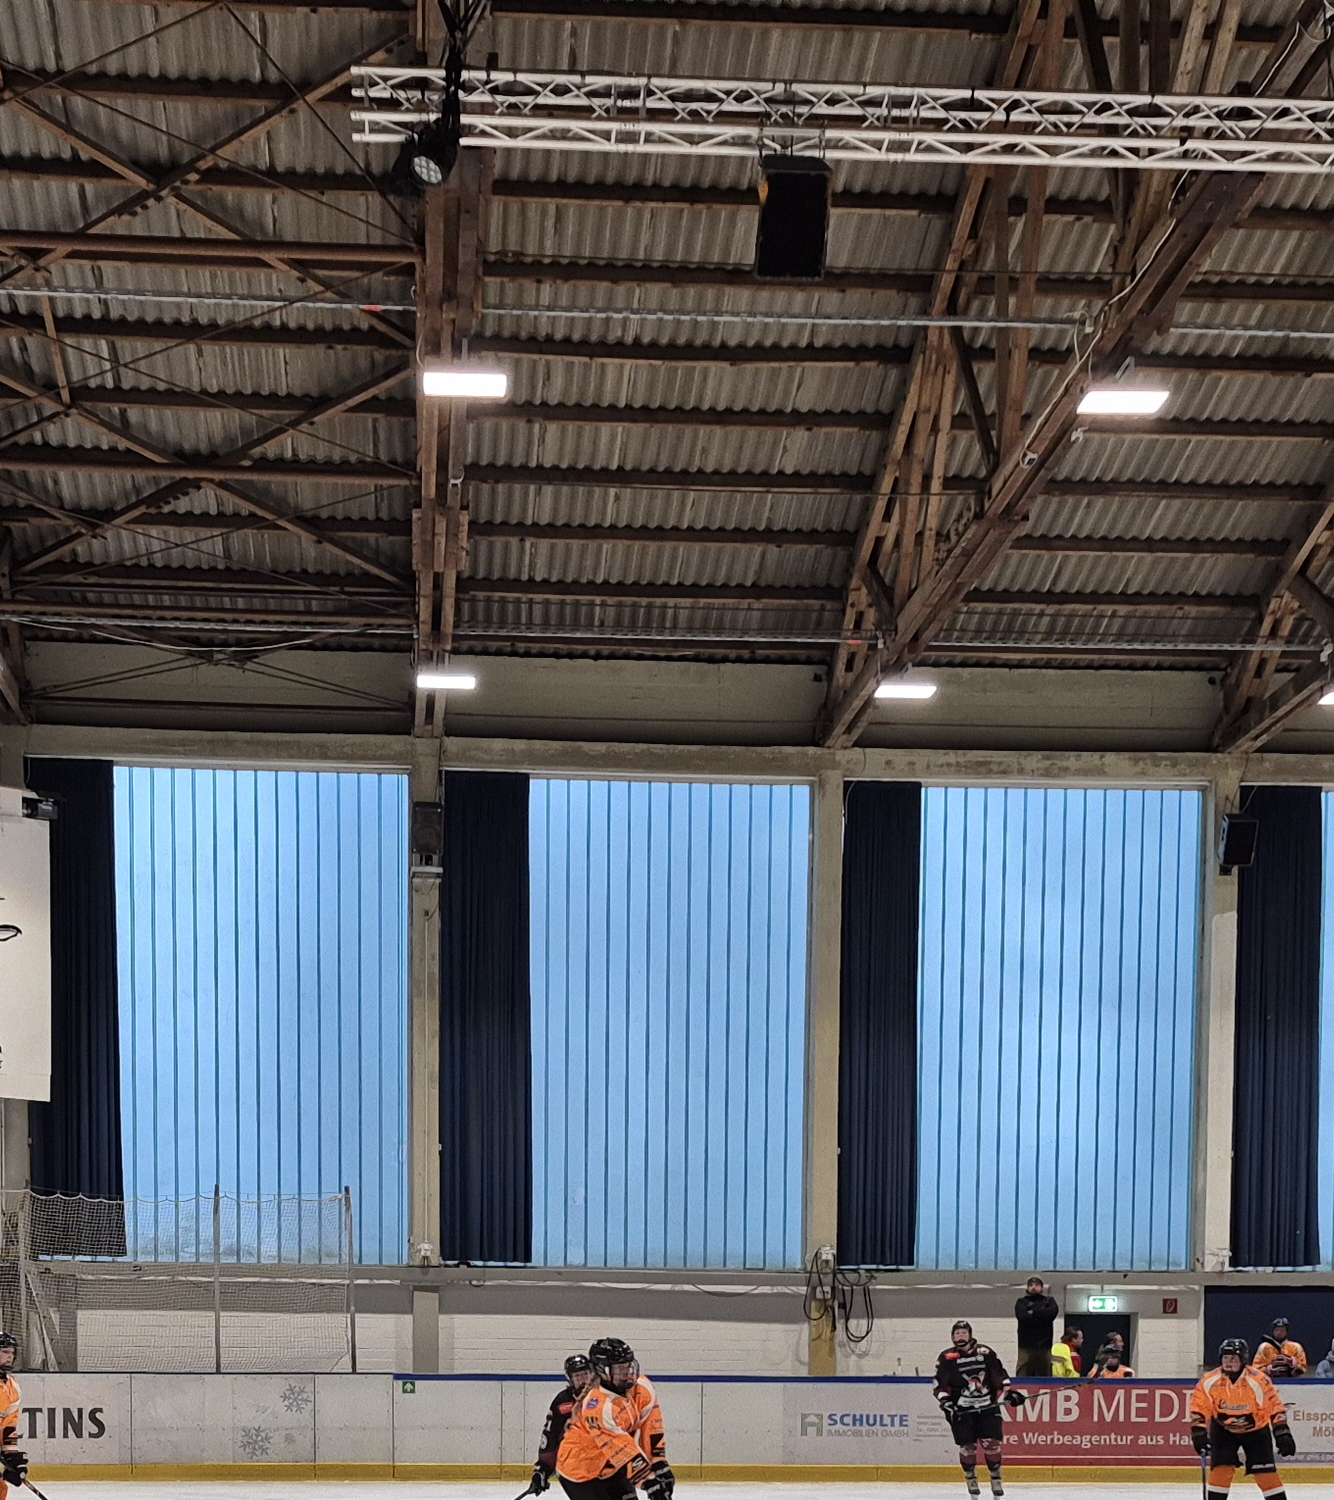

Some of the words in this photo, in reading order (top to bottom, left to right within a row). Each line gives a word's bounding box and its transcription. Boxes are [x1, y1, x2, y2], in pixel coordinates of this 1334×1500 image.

[17, 1407, 106, 1439] TINS
[827, 1413, 910, 1428] SCHULTE
[1023, 1432, 1134, 1449] Werbeagentur
[1137, 1434, 1165, 1446] aus
